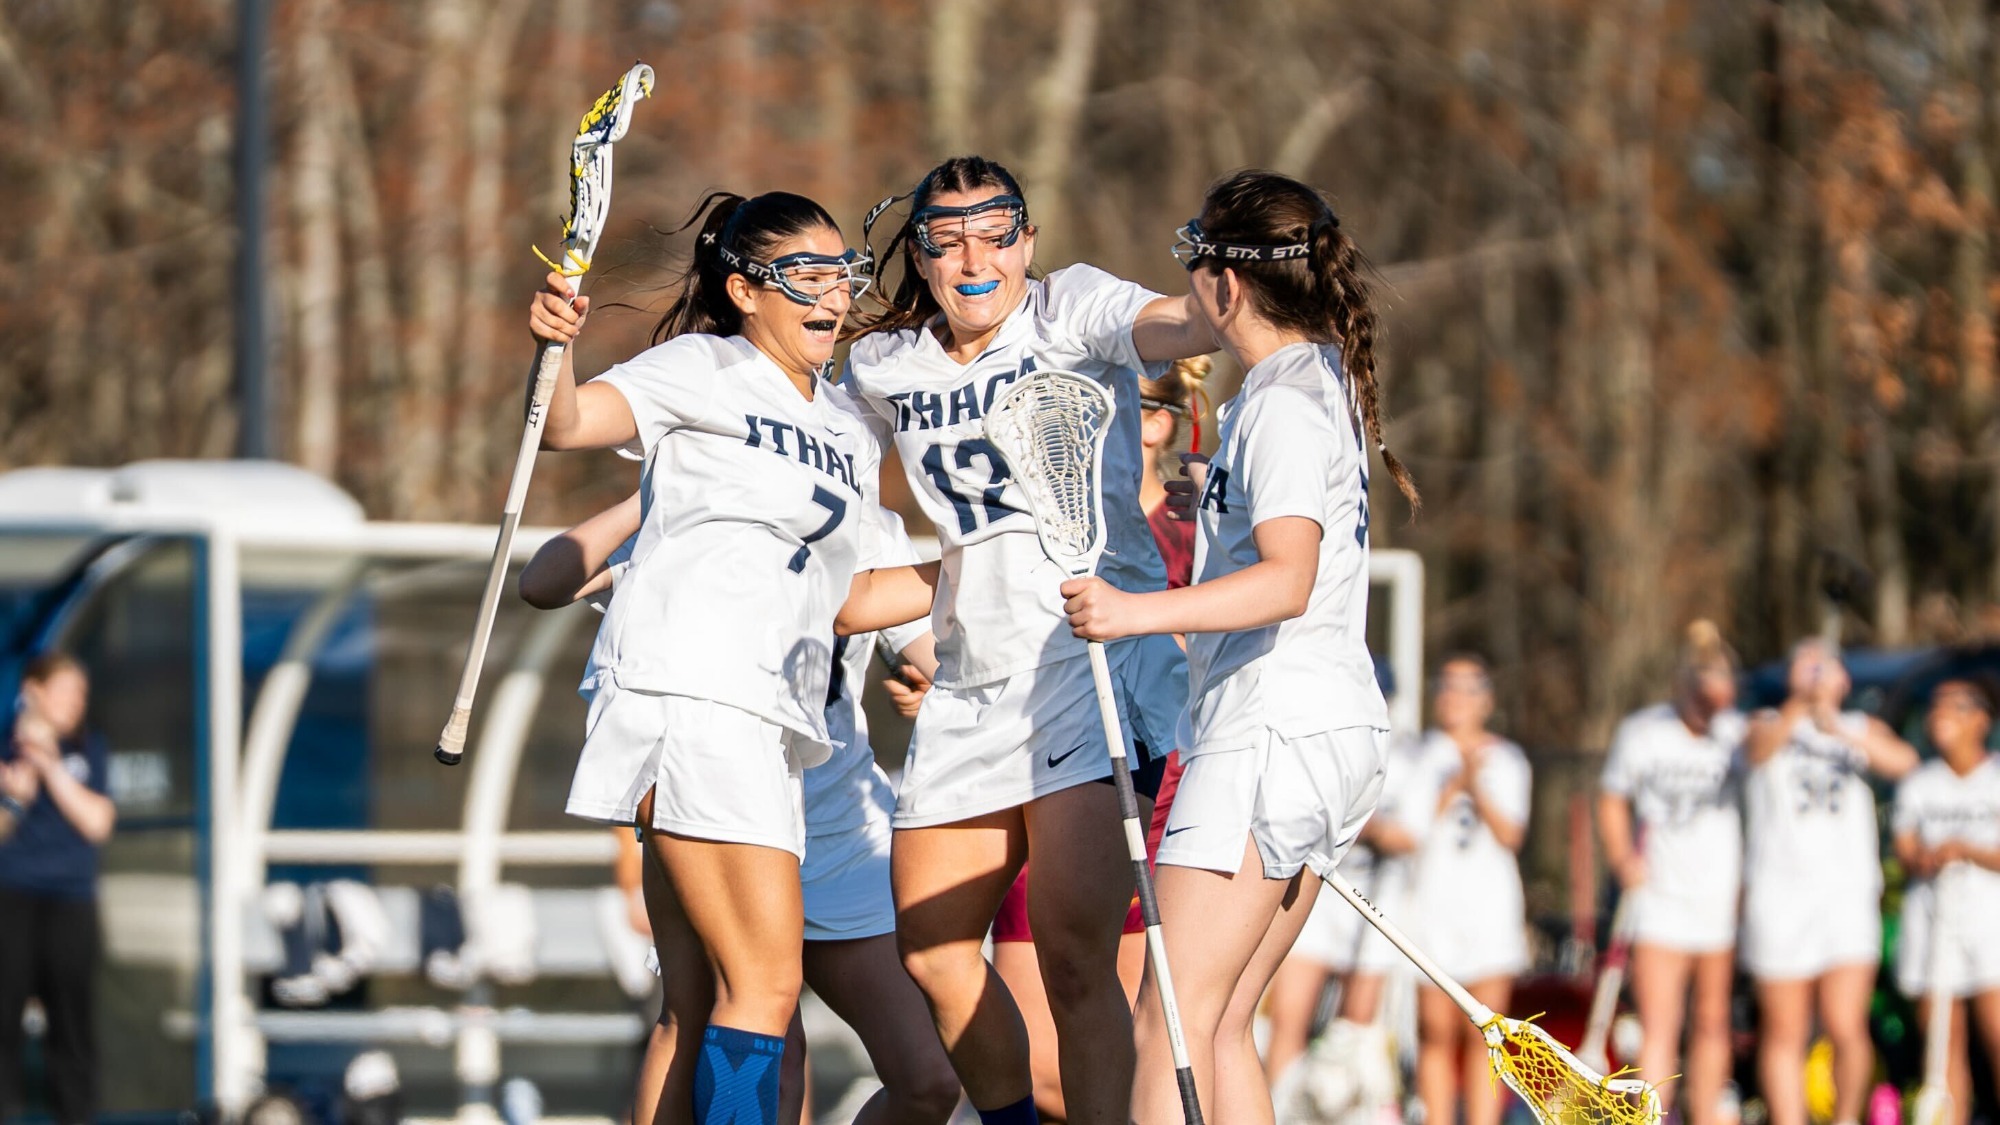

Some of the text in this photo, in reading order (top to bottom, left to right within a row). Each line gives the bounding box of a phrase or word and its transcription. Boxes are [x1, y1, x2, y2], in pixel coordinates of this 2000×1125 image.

[720, 246, 741, 268] STX
[1197, 242, 1310, 260] TX STX STX
[744, 413, 864, 502] ITHAC
[920, 437, 1018, 537] 12
[786, 483, 848, 575] 7
